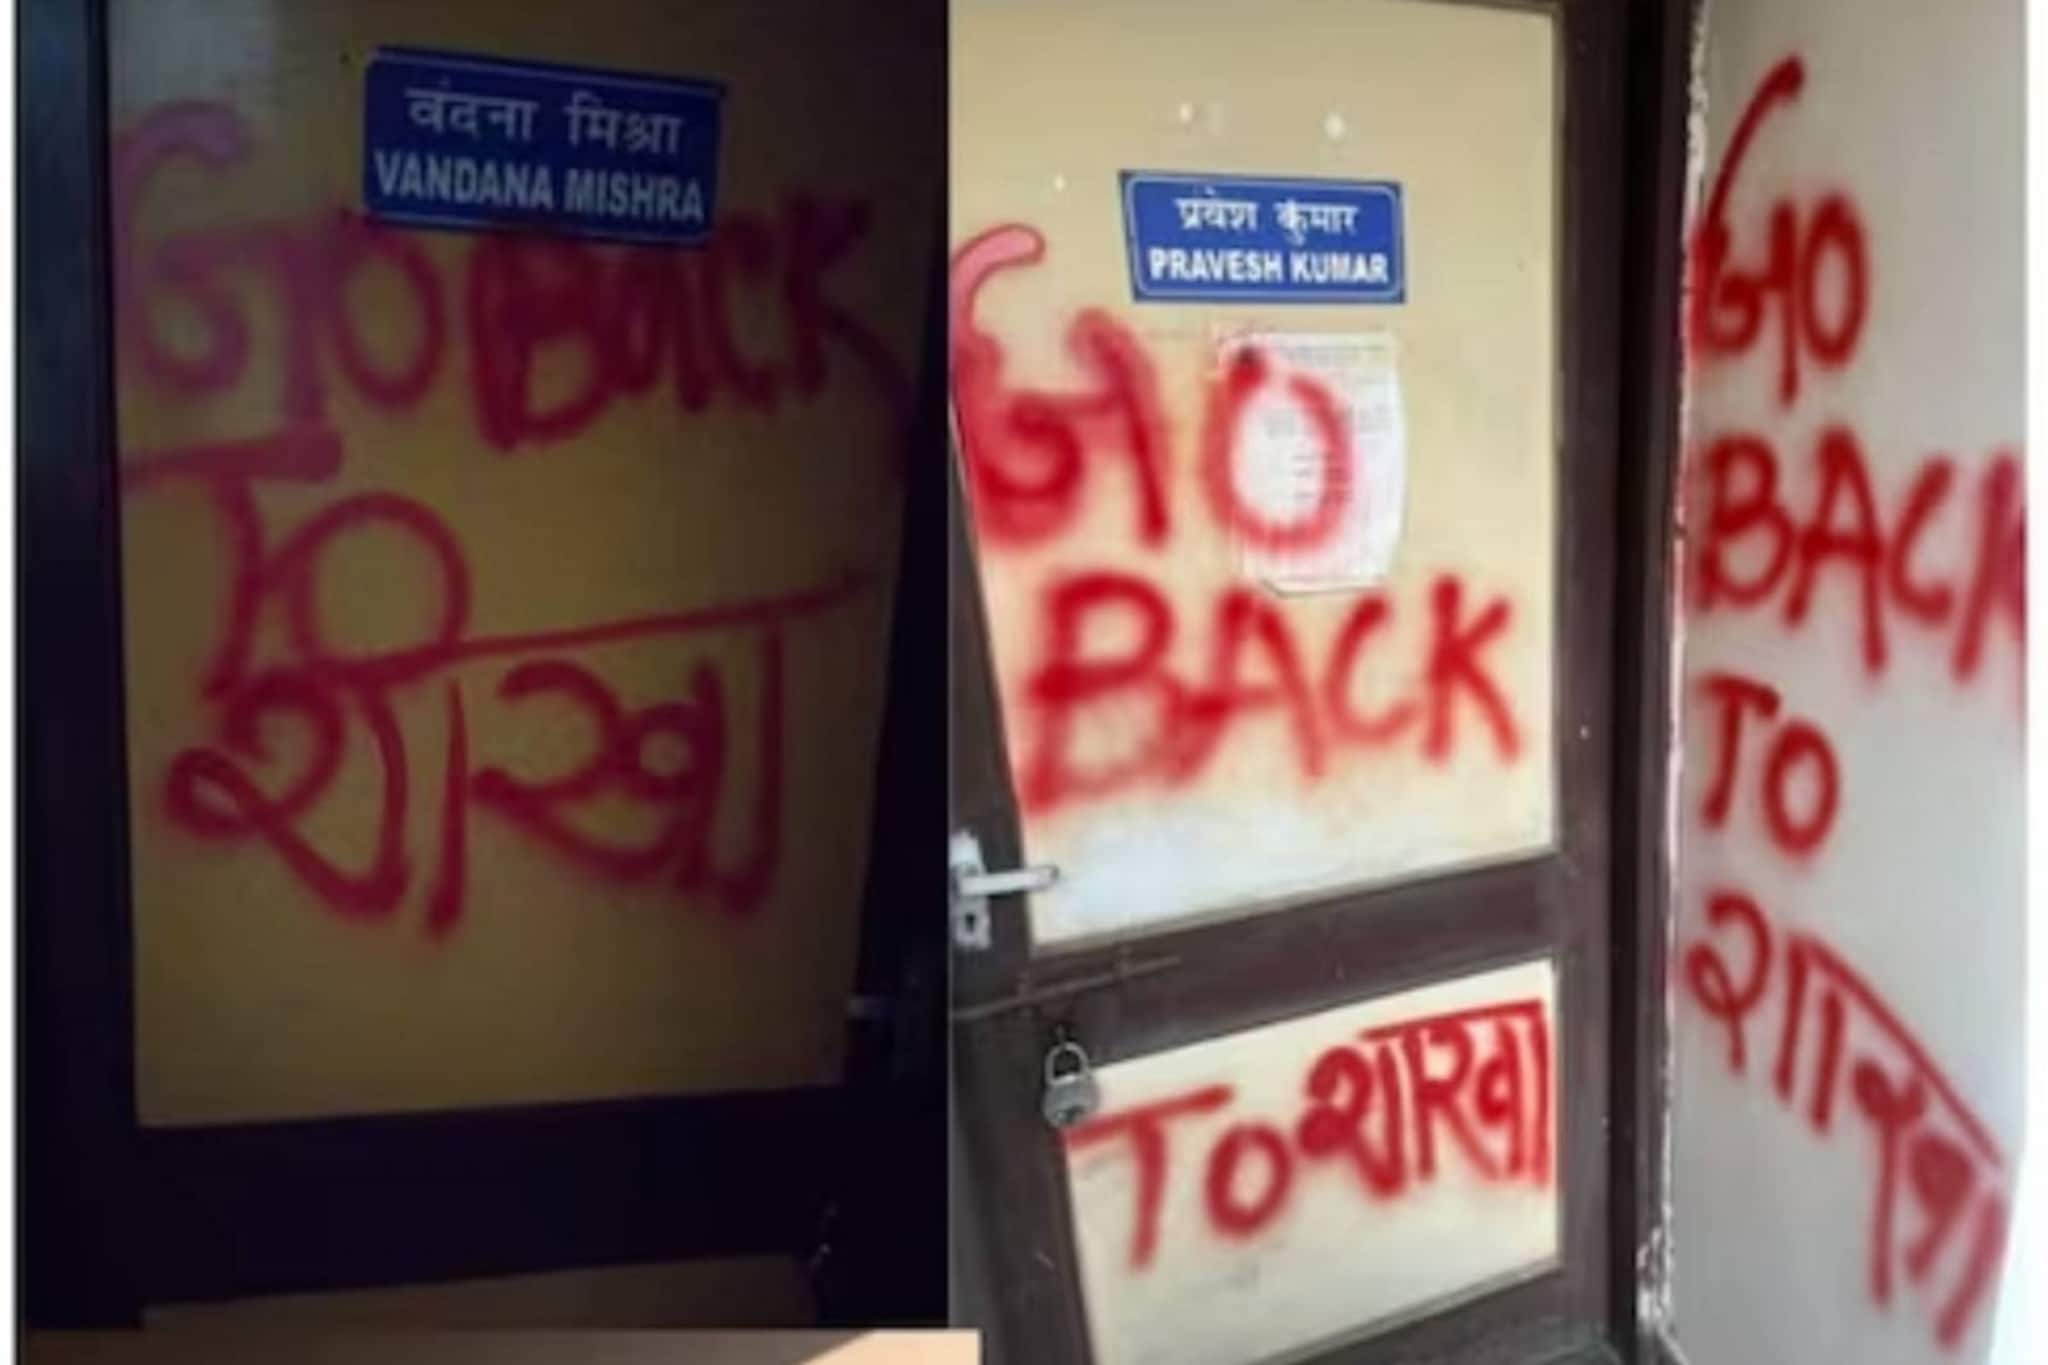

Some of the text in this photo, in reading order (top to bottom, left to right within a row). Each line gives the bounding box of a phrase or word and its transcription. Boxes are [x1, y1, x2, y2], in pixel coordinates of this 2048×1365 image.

[373, 149, 706, 223] VANDANA MISHRA
[403, 78, 687, 155] वंदना मिश्रा
[1148, 247, 1390, 284] PRAVESH KUMAR
[1688, 55, 1870, 405] GO
[950, 224, 1358, 552] GO
[118, 425, 472, 705] TO
[1020, 570, 1525, 818] BACK
[1700, 672, 1842, 862] TO
[1066, 1083, 1296, 1272] TO
